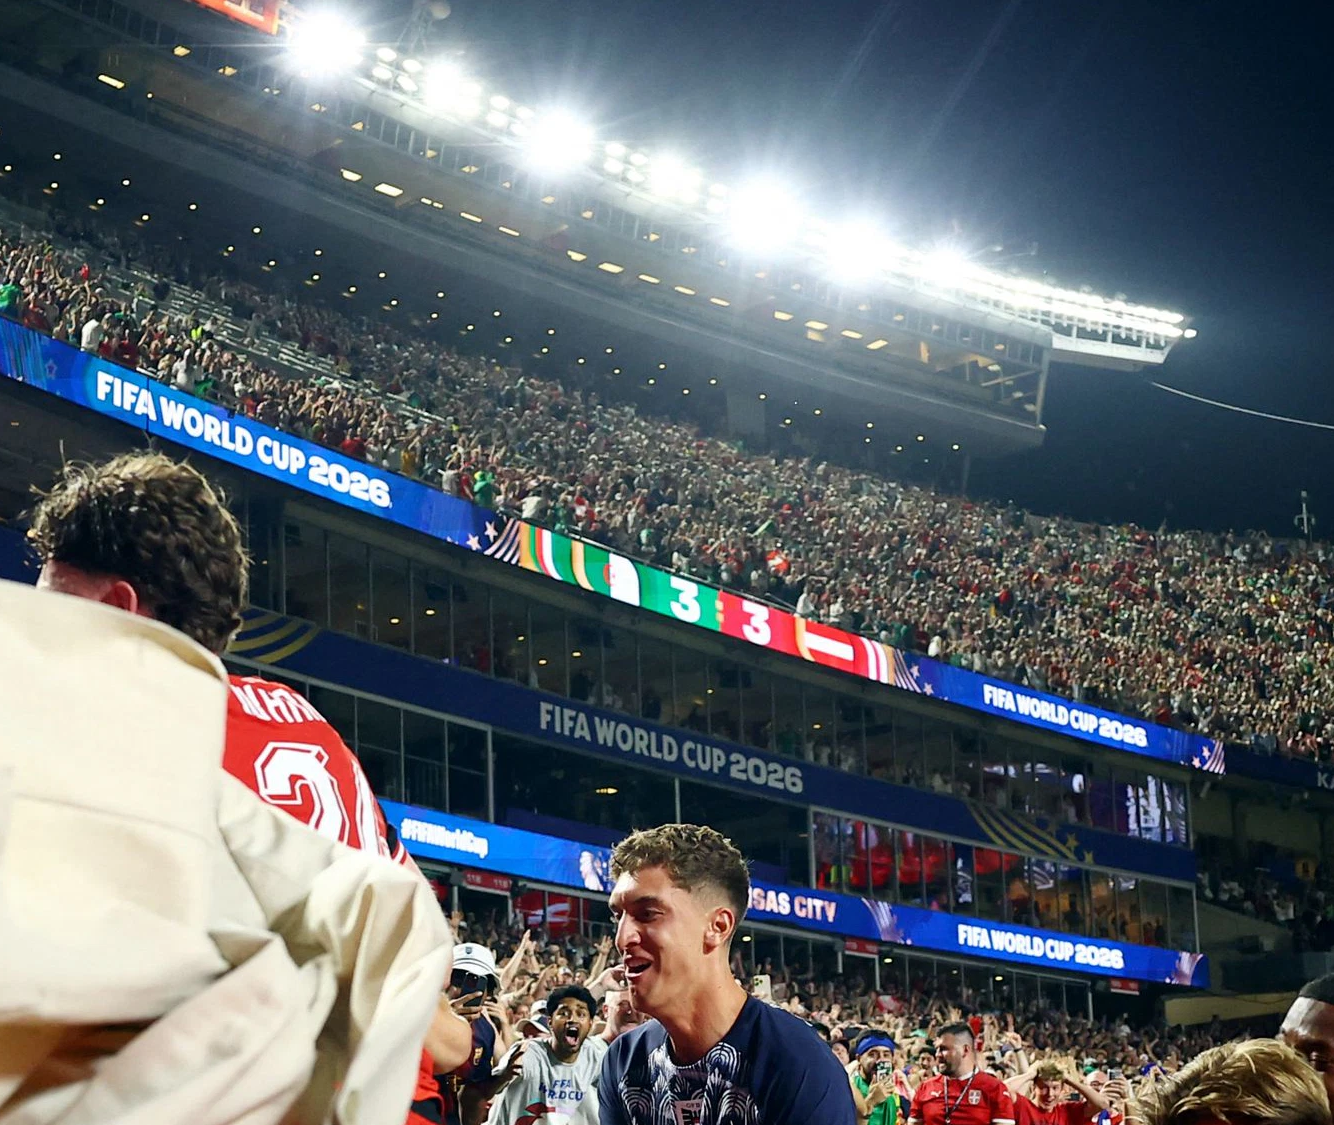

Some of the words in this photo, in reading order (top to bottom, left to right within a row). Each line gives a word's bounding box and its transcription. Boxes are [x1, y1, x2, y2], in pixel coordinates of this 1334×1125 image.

[97, 371, 157, 421] FIFA
[159, 395, 254, 456] WORLD
[257, 435, 306, 475] CUP
[308, 455, 391, 508] 2026
[670, 576, 700, 623] 3
[742, 600, 771, 646] 3
[540, 701, 591, 742] FIFA
[594, 716, 679, 762] WORLD
[682, 740, 726, 774] CUP
[730, 752, 803, 794] 2026
[982, 684, 1016, 712] FIFA
[1016, 693, 1068, 726] WORLD
[1069, 709, 1099, 734] CUP
[1099, 717, 1148, 748] 2026
[794, 895, 837, 923] CITY
[957, 924, 991, 949] FIFA
[991, 929, 1044, 957] WORLD
[1045, 939, 1074, 962] CUP
[1075, 943, 1124, 969] 2026
